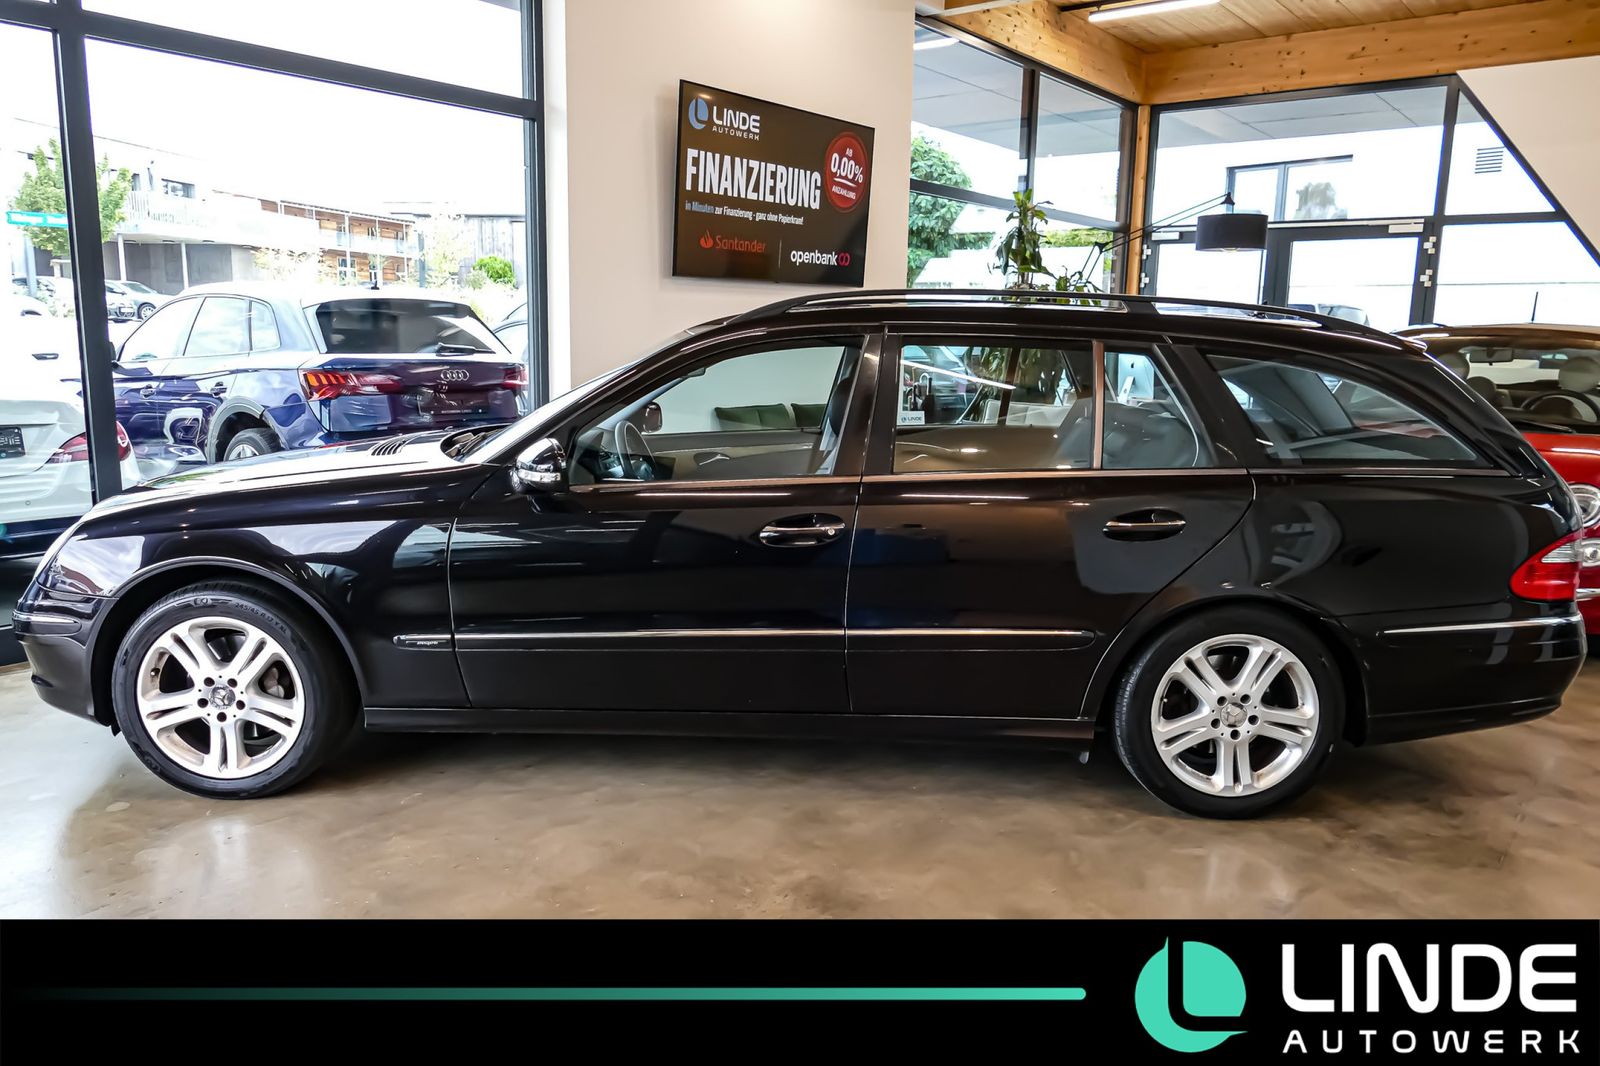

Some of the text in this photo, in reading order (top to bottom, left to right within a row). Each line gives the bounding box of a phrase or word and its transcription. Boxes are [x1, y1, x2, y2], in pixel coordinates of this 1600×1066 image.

[712, 105, 760, 133] LINDE
[712, 125, 760, 141] AUTOWERK
[846, 147, 853, 157] AB
[831, 152, 863, 183] 0,00%
[685, 148, 821, 210] FINANZIERUNG
[714, 207, 723, 215] zur
[723, 206, 753, 220] Finanzierung
[756, 212, 766, 221] ganz
[767, 212, 778, 222] ohne
[715, 235, 766, 253] Santander
[791, 250, 837, 266] openbank
[234, 602, 260, 615] 245/45
